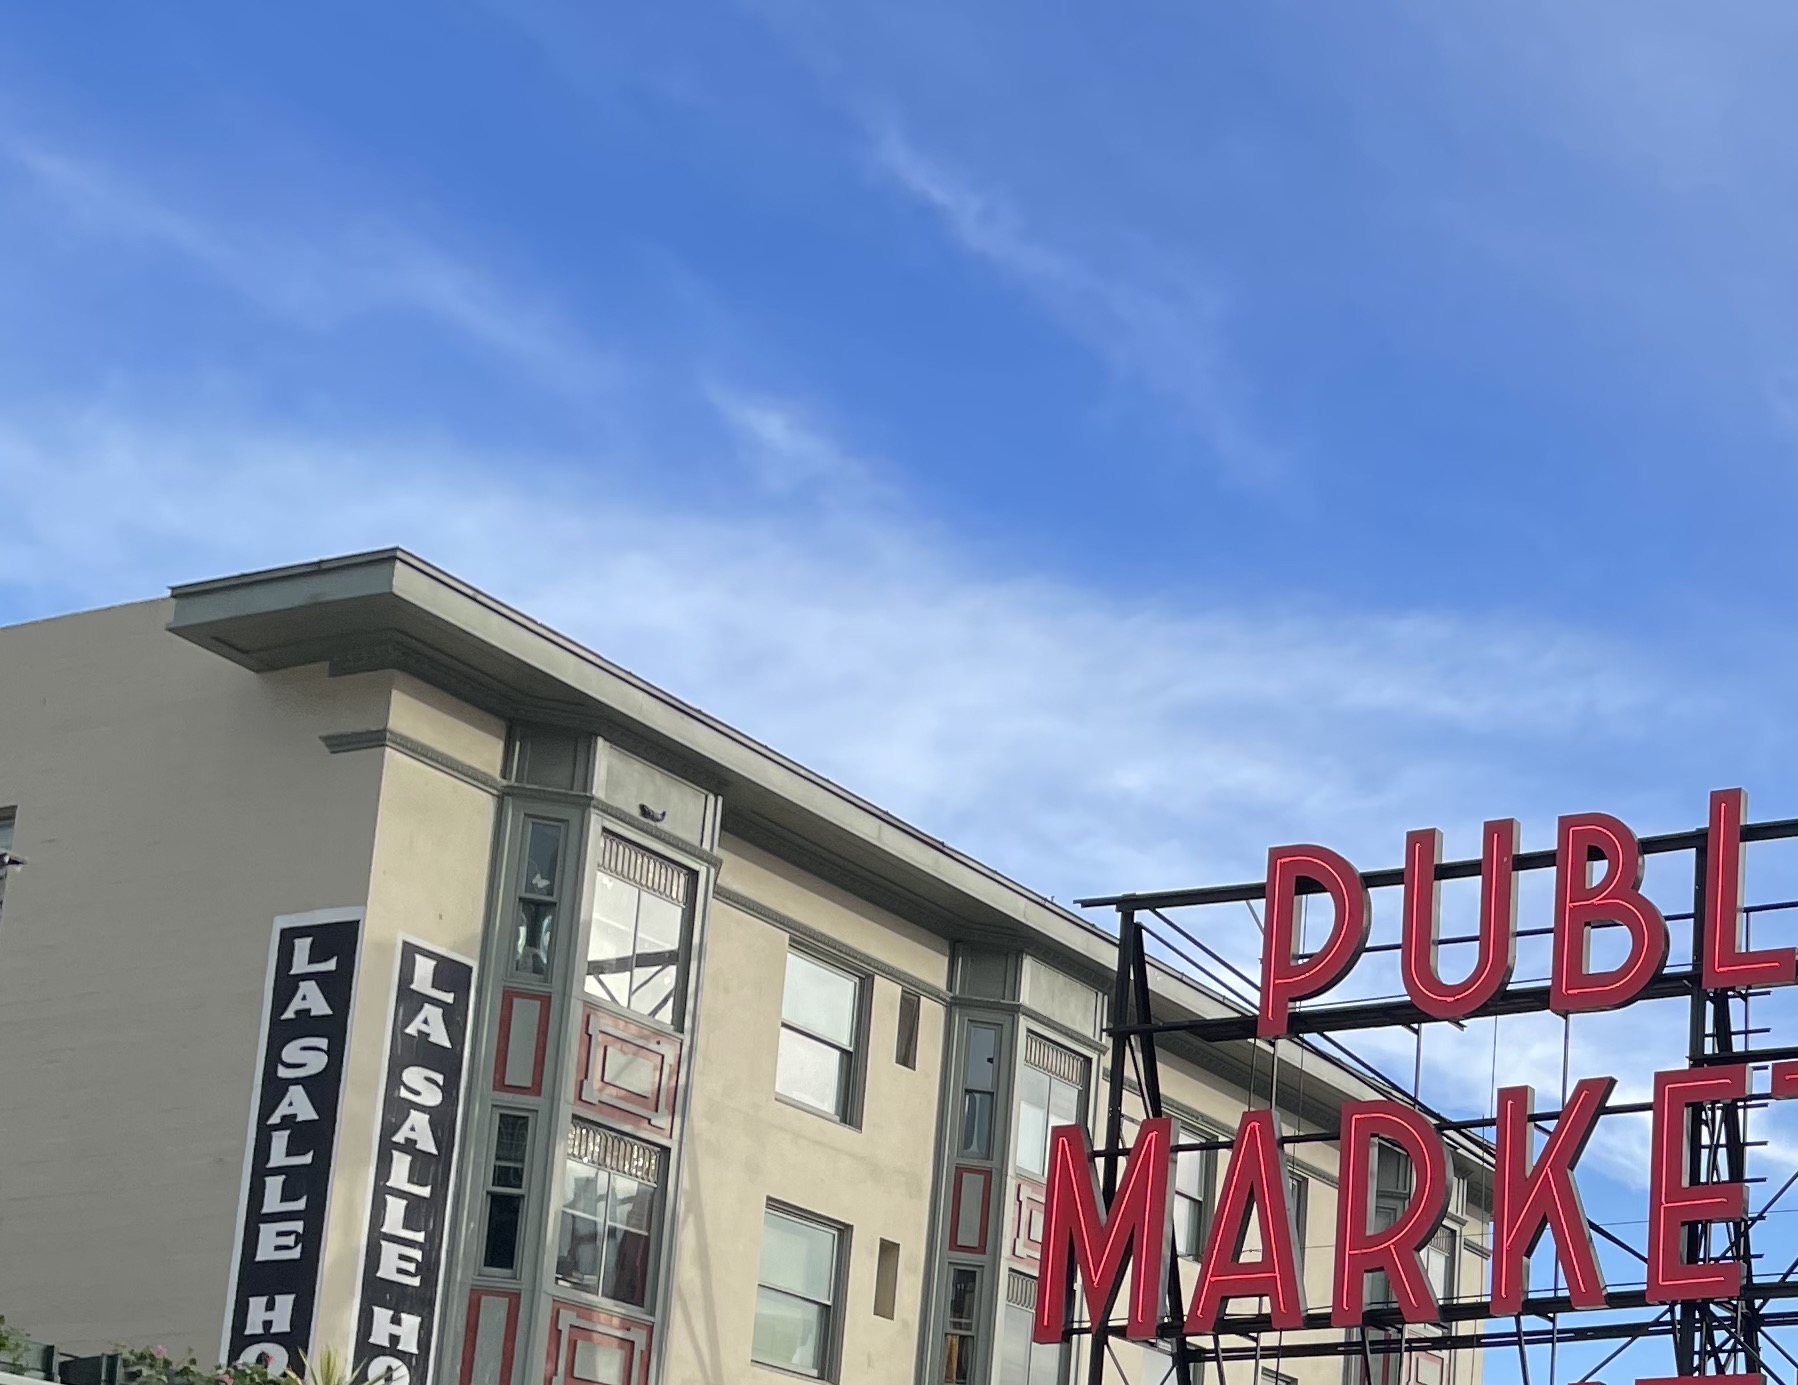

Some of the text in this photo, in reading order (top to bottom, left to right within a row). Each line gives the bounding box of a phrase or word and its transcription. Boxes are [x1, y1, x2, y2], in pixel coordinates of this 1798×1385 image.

[280, 937, 338, 1021] LA
[404, 952, 456, 1050] LA
[255, 1037, 328, 1262] SALLE
[374, 1066, 445, 1288] SALLE
